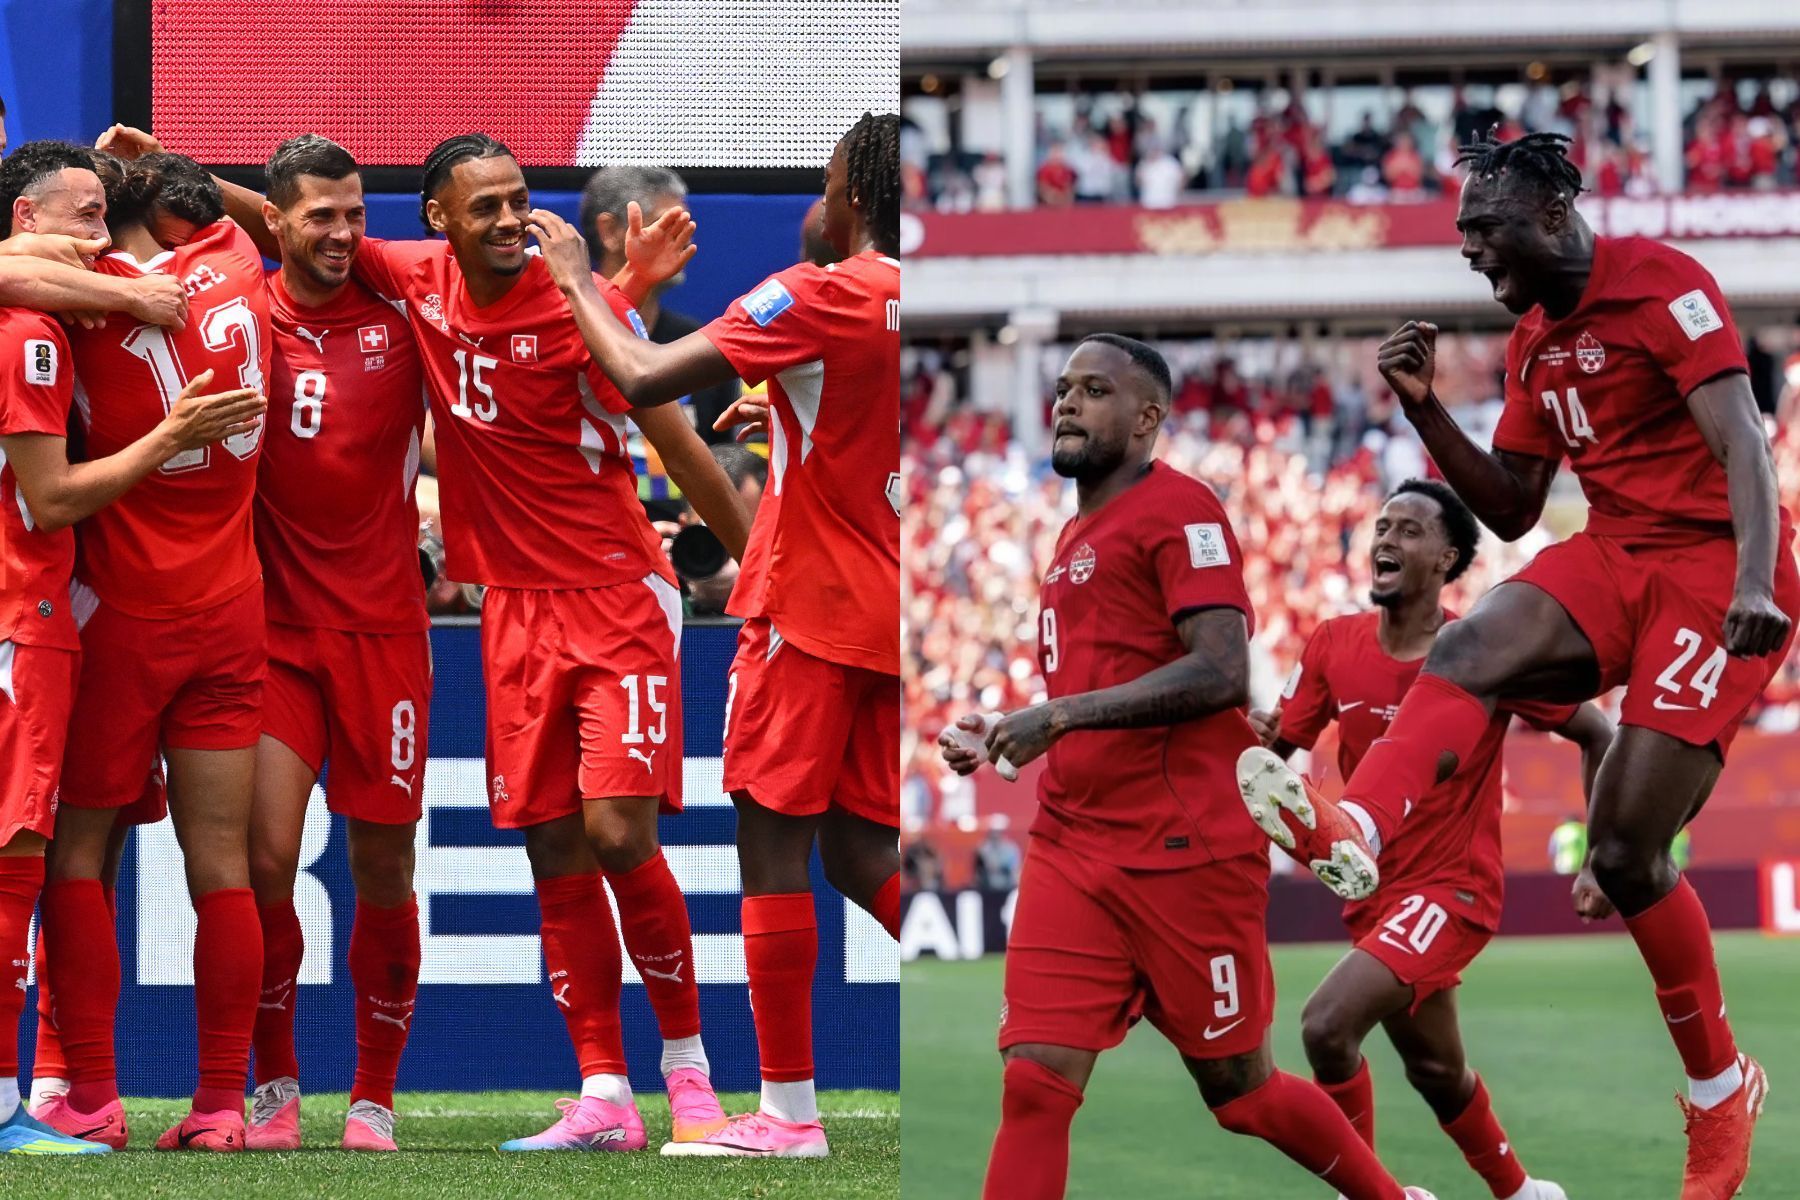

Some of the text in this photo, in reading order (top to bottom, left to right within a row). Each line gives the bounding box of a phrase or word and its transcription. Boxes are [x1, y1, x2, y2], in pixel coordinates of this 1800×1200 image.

[291, 370, 327, 438] 8
[451, 349, 498, 422] 15
[1541, 387, 1600, 448] 24
[1042, 607, 1059, 673] 9
[1654, 627, 1728, 709] 24
[391, 700, 415, 770] 8
[620, 674, 668, 744] 15
[1383, 894, 1448, 955] 20
[1210, 954, 1240, 1018] 9
